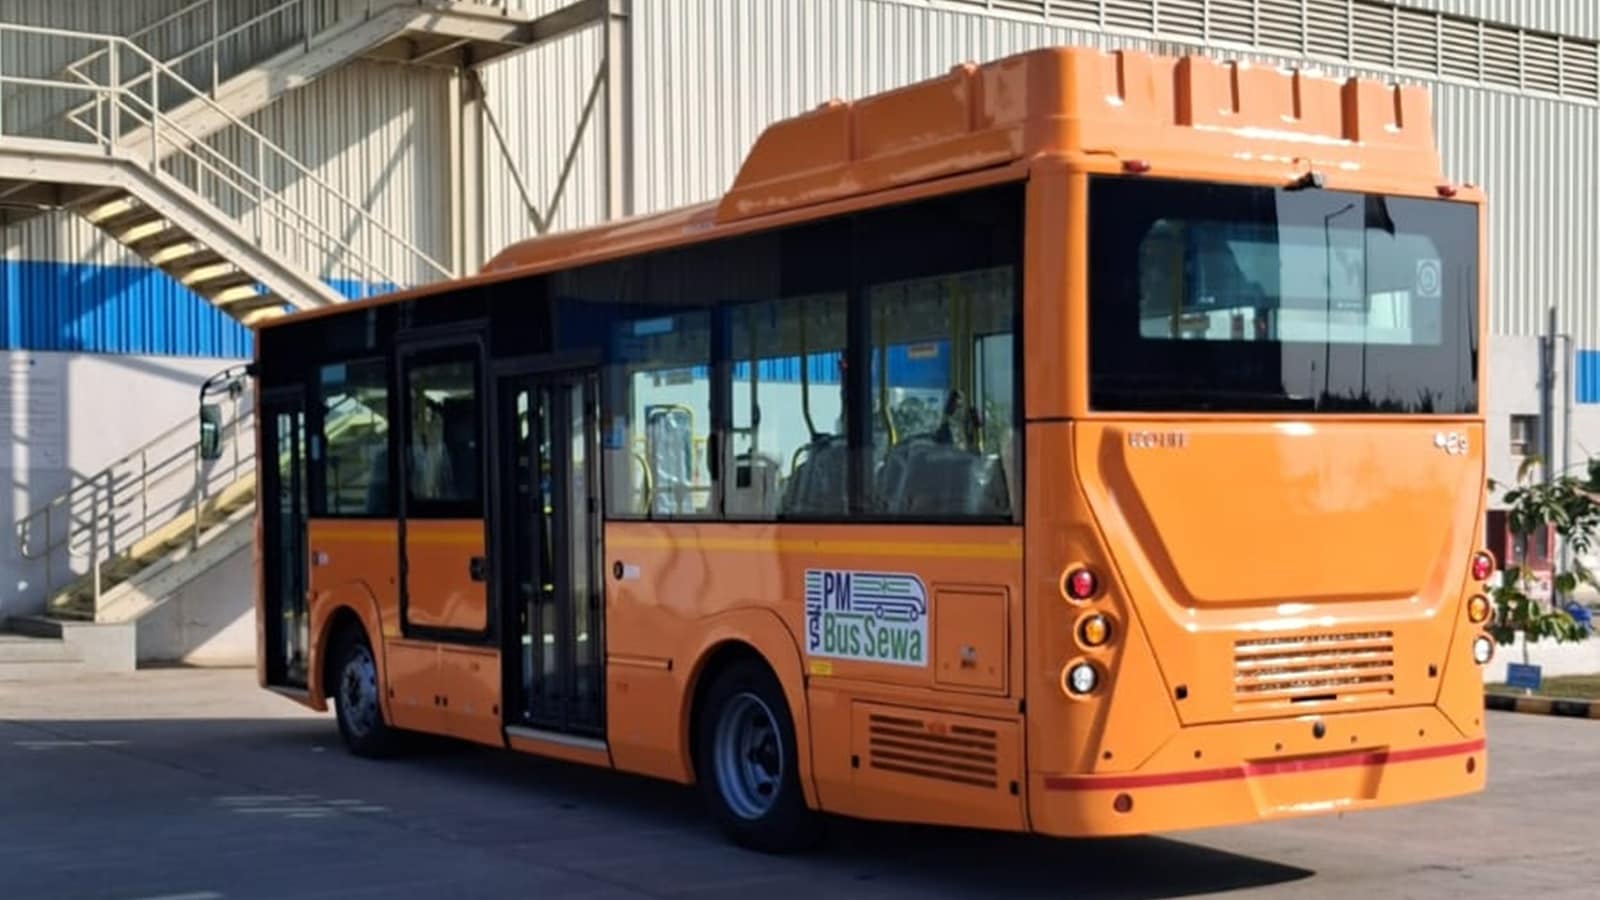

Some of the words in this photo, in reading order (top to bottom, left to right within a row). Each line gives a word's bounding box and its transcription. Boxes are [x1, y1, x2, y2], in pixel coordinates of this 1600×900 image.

[823, 571, 851, 611] PM
[823, 612, 861, 655] Bus
[863, 615, 922, 661] Sewa
